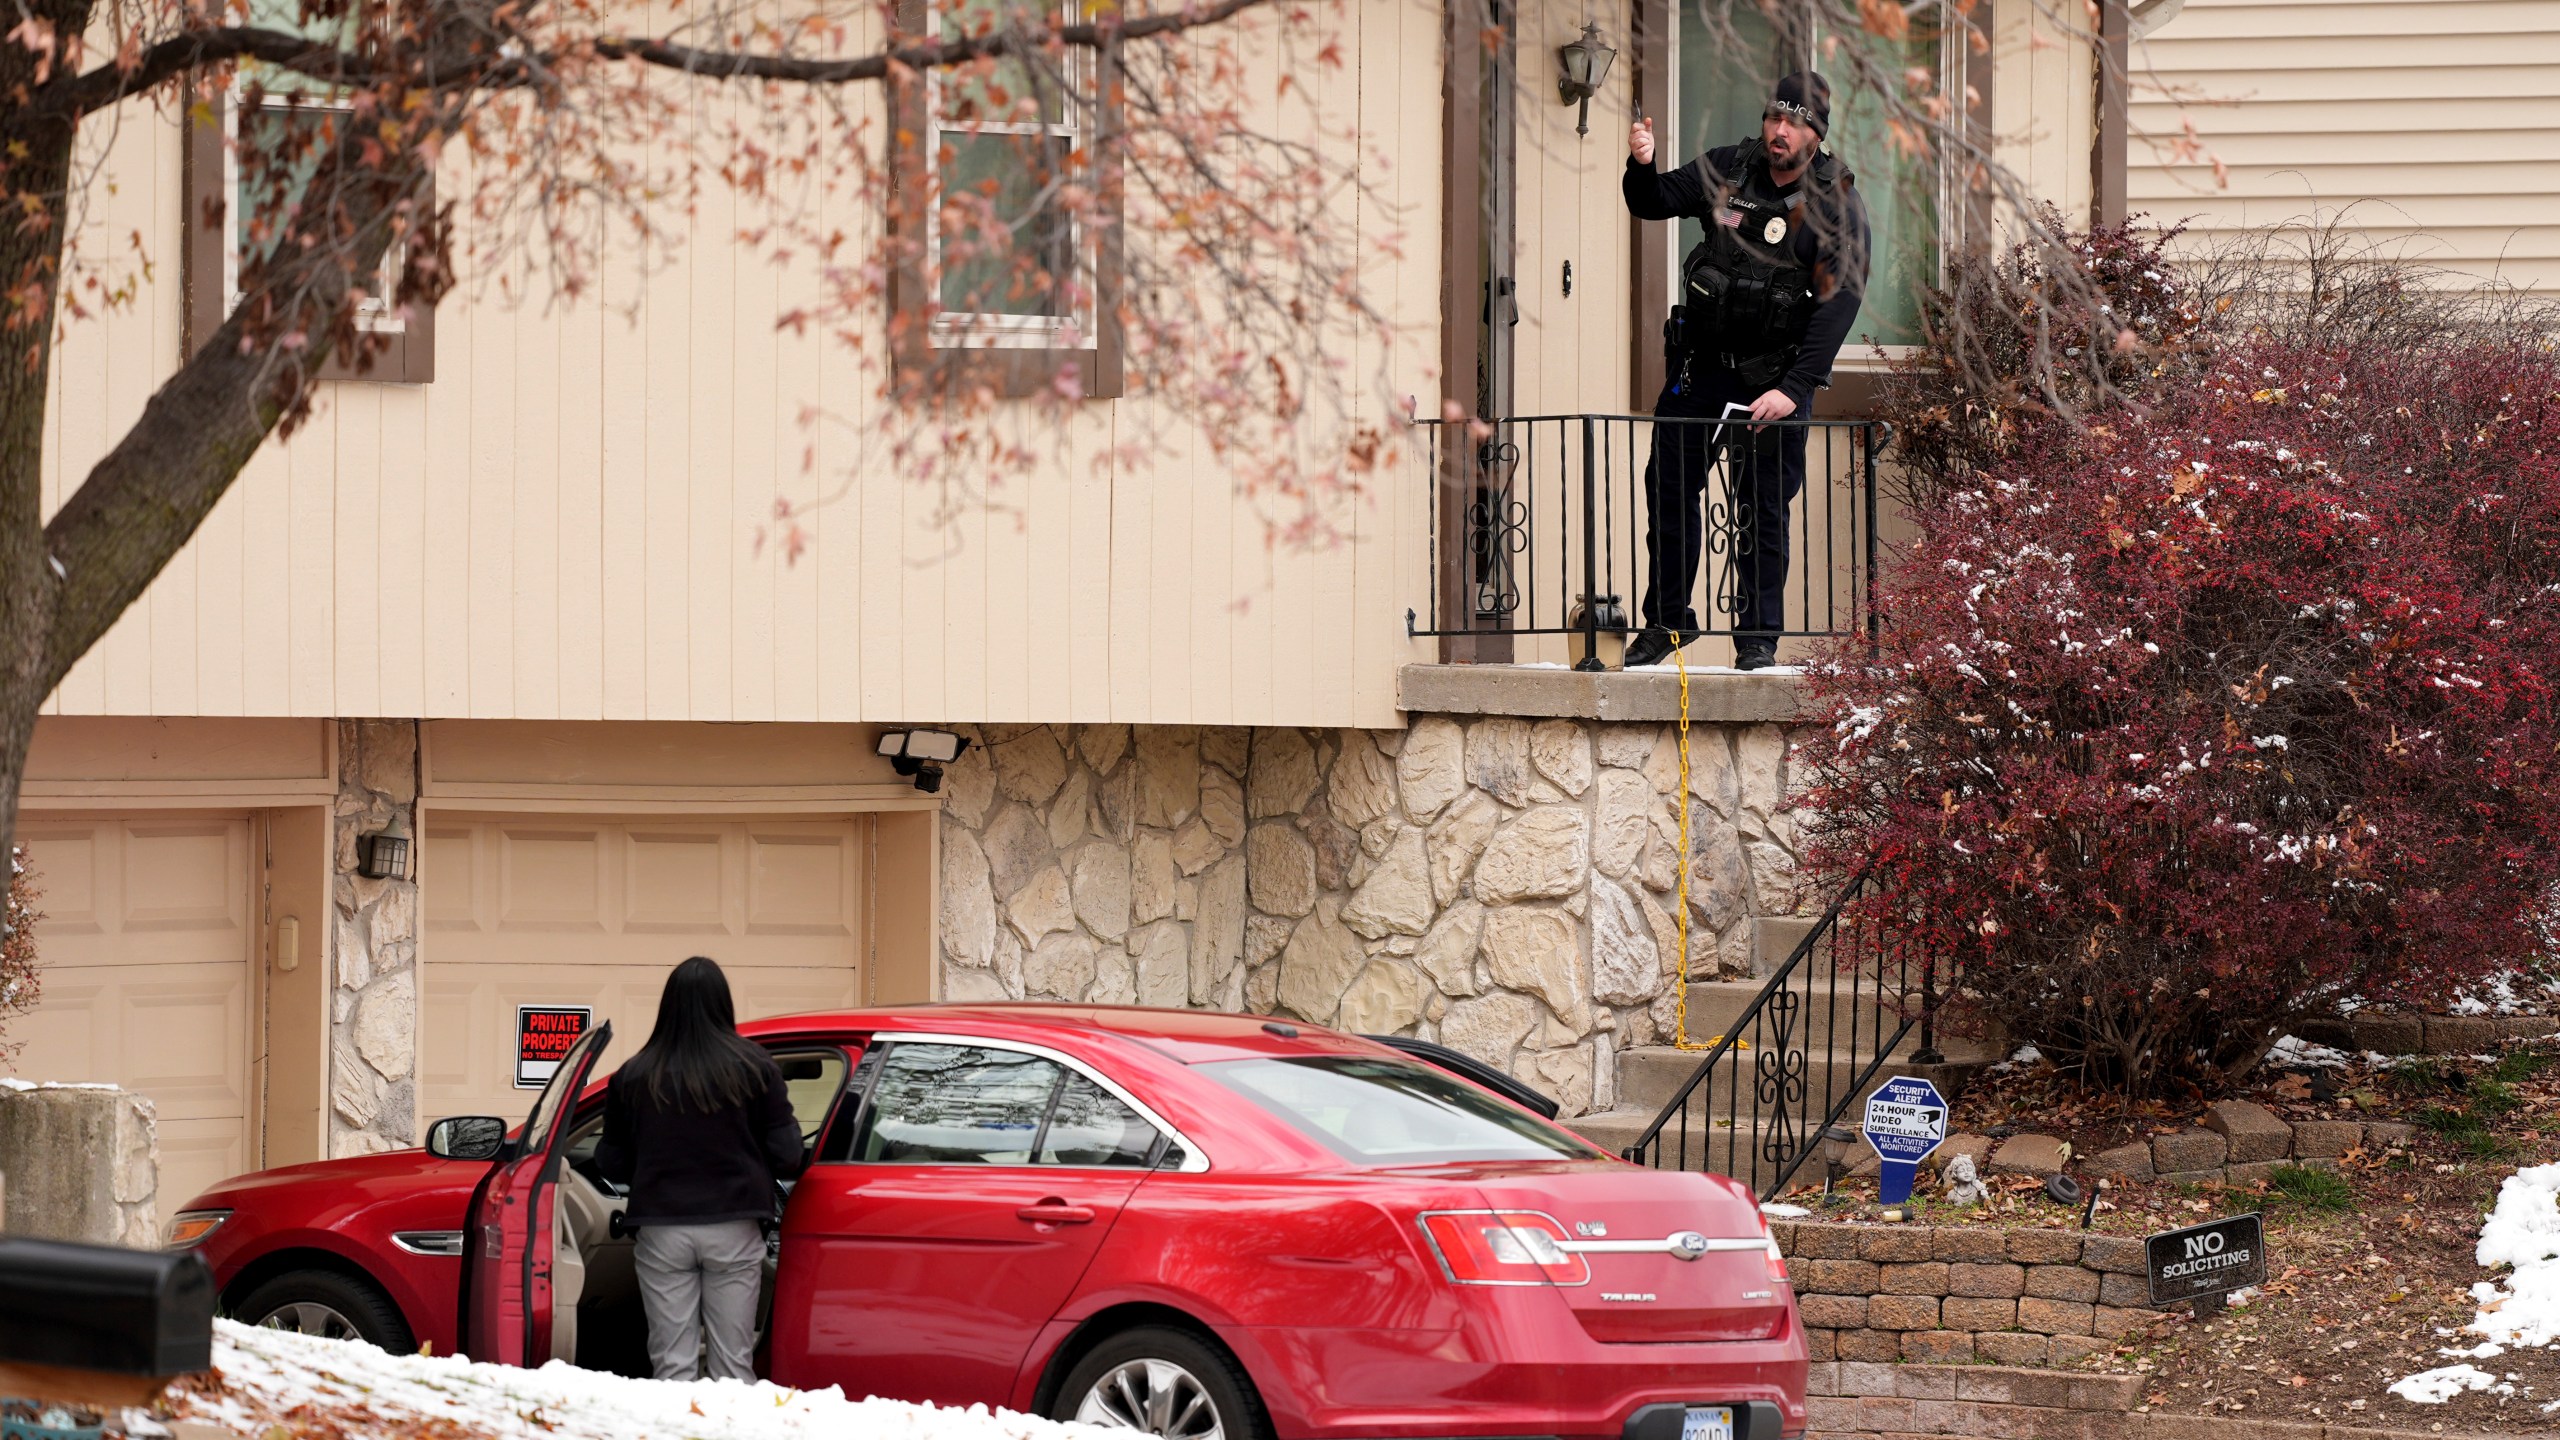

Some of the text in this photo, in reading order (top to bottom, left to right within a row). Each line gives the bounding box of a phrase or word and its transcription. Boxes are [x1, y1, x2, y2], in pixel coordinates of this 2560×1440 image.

[1769, 100, 1814, 121] POLICE
[1733, 198, 1758, 209] GULLEY
[530, 1013, 580, 1032] PRIVATE
[522, 1032, 580, 1050] PROPERT
[522, 1051, 566, 1059] NO TRESPA
[1889, 1084, 1931, 1097] SECURITY
[1894, 1094, 1922, 1105] ALERT
[1872, 1103, 1916, 1117] 24 HOUR
[1871, 1114, 1902, 1126] VIDEO
[1869, 1124, 1929, 1138] SURVEILLANCE
[1879, 1135, 1929, 1148] ALL ACTIVITIES
[1880, 1142, 1923, 1154] MONITORED
[2184, 1231, 2224, 1259] NO
[2163, 1249, 2250, 1279] SOLICITING
[1600, 1292, 1657, 1302] TAURUS
[1742, 1290, 1772, 1299] LIMITED
